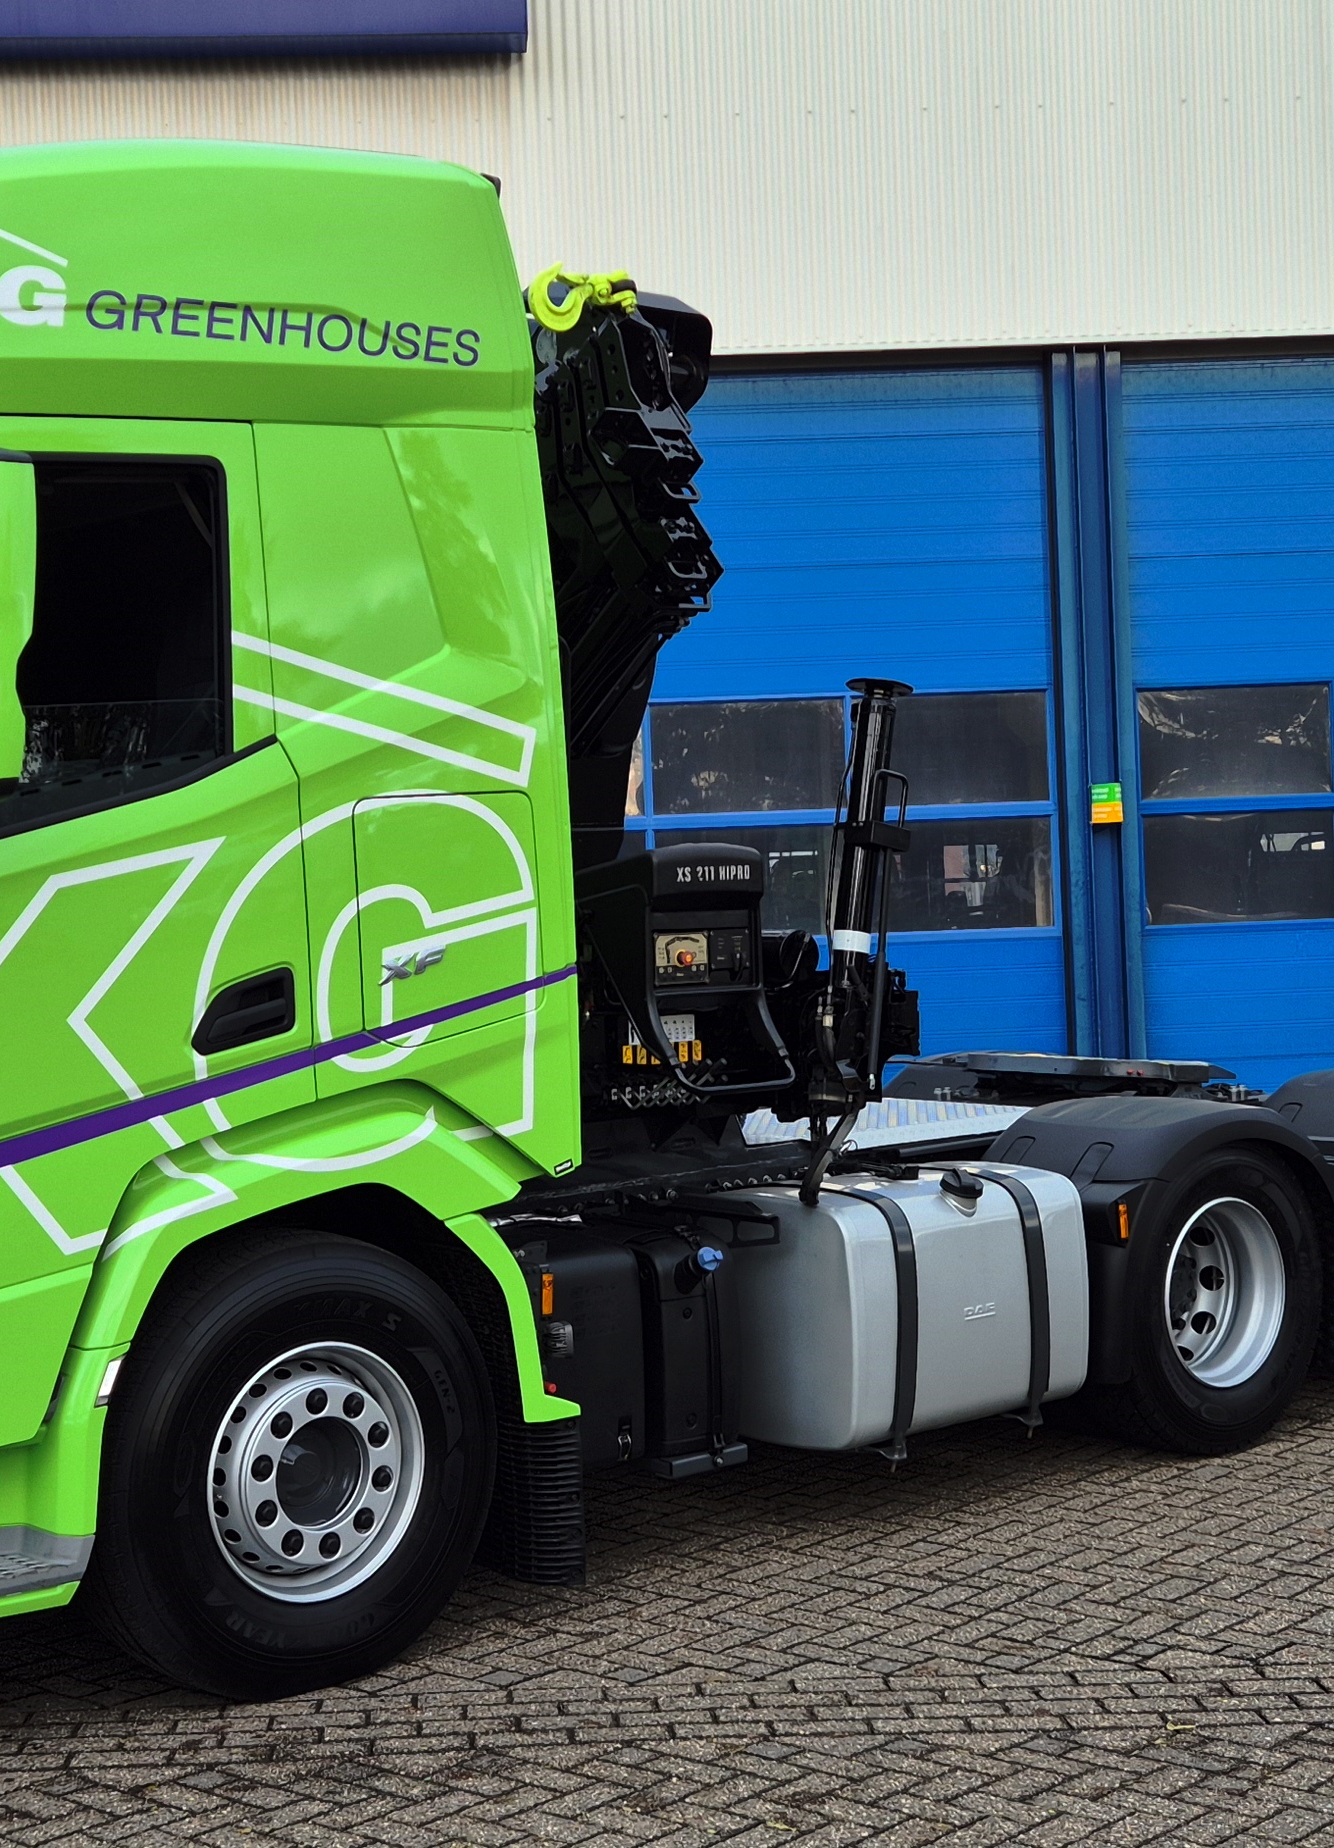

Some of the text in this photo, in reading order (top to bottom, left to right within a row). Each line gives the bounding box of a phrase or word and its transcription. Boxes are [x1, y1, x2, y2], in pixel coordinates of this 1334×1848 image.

[85, 289, 480, 367] GREENHOUSES
[676, 866, 692, 882] XS
[718, 864, 750, 880] HIPRO
[378, 944, 446, 986] XF
